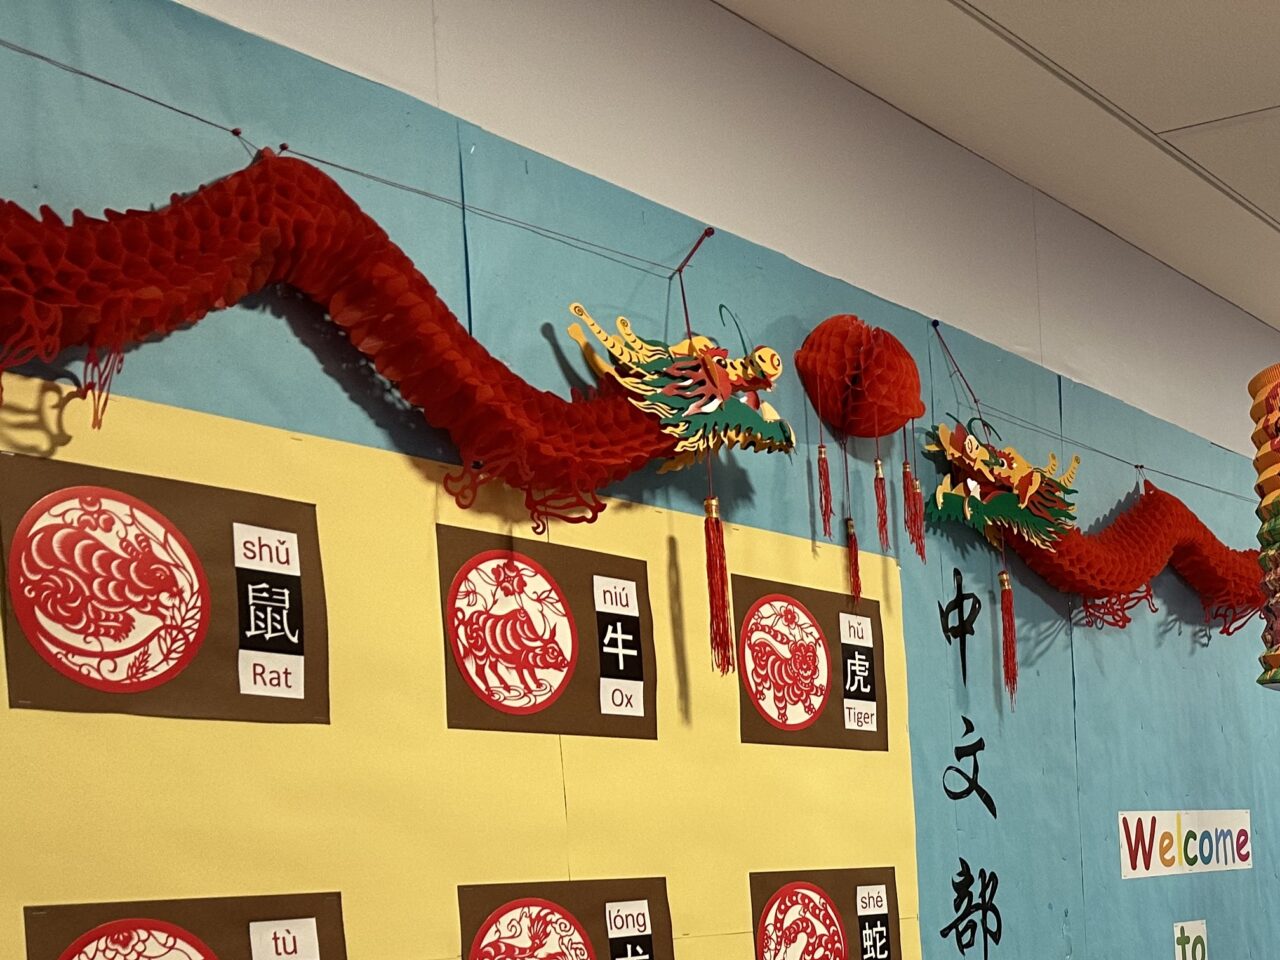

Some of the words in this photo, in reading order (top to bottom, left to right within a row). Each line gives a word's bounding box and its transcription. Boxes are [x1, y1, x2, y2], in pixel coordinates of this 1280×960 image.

[602, 586, 630, 608] niú
[245, 582, 300, 644] 鼠
[603, 621, 638, 670] 牛
[251, 662, 293, 689] Rat
[845, 651, 871, 693] 虎
[611, 688, 634, 708] Ox
[846, 706, 875, 727] Tiger
[1122, 811, 1251, 871] Welcome
[860, 891, 884, 910] shé
[608, 908, 647, 933] lóng
[272, 929, 298, 956] tù
[862, 920, 888, 960] 蛇
